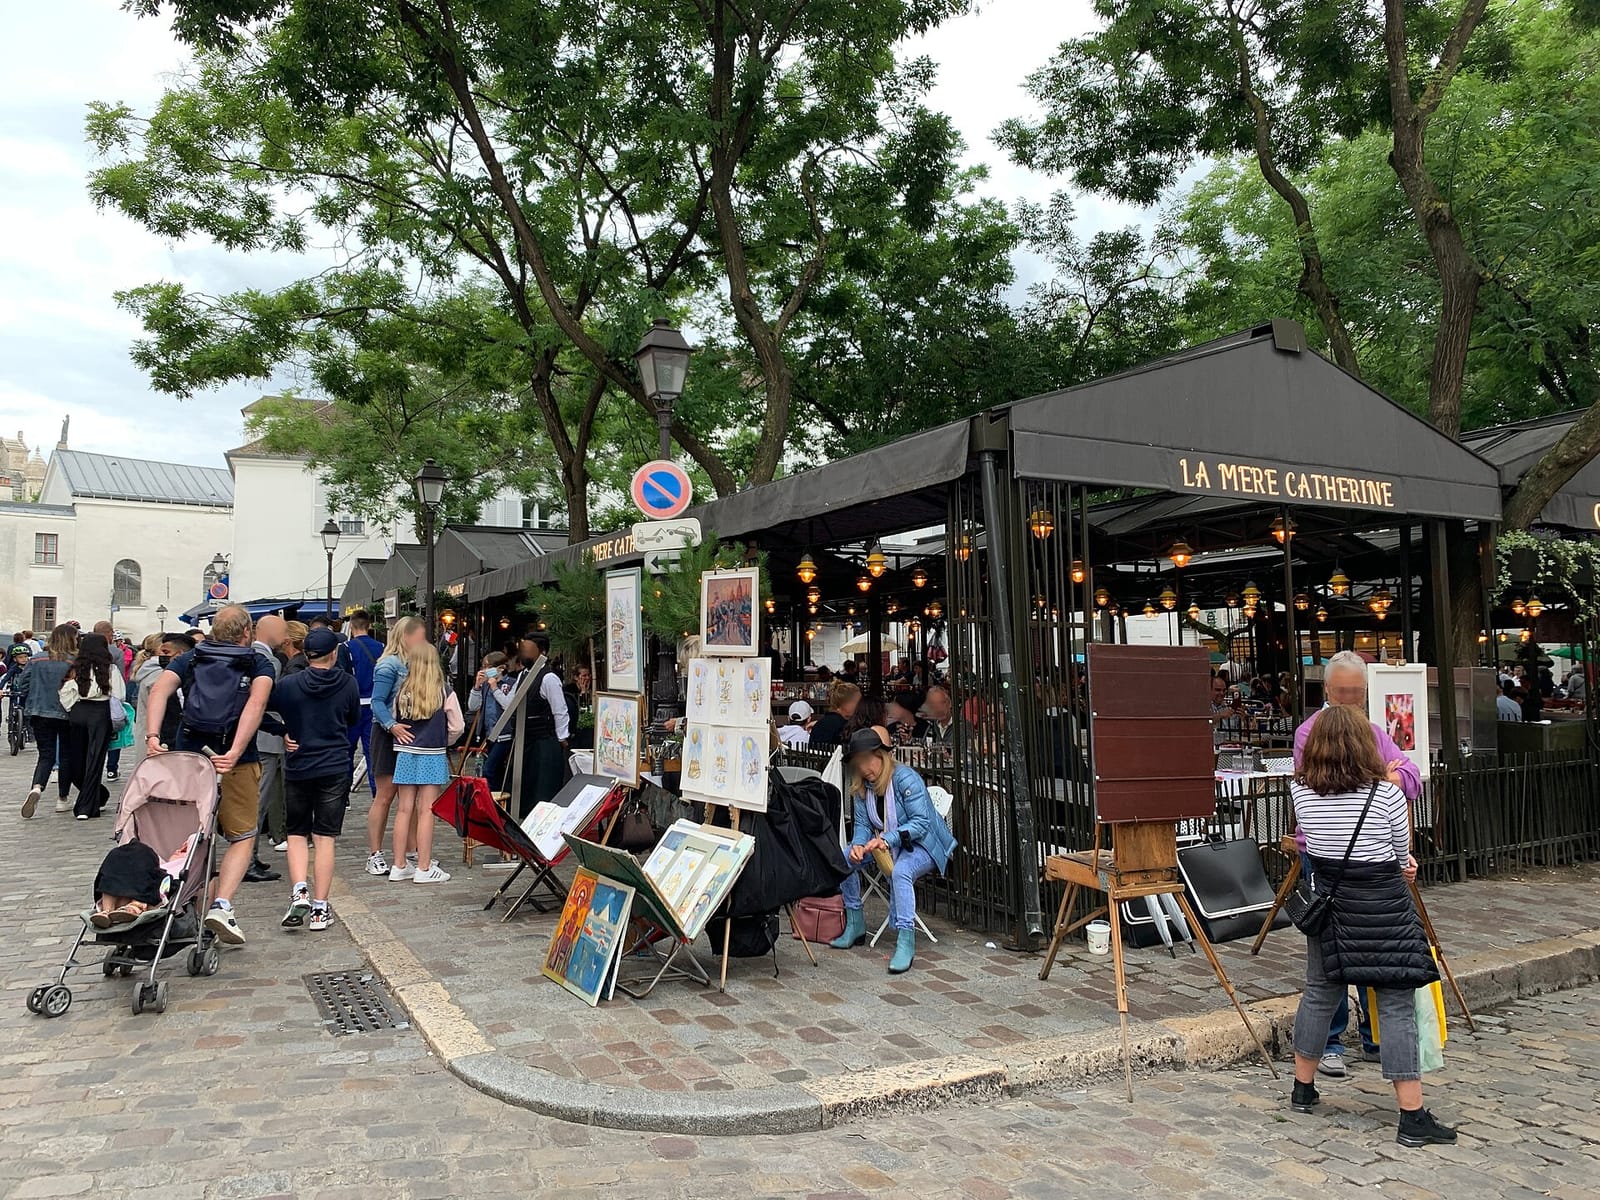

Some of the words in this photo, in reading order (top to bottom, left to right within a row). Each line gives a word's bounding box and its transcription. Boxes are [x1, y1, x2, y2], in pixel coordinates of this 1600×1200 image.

[1180, 458, 1211, 489] LA
[1218, 463, 1279, 496] MERE
[1285, 471, 1394, 507] CATHERINE
[592, 540, 613, 563] MERE
[614, 534, 636, 557] CATH
